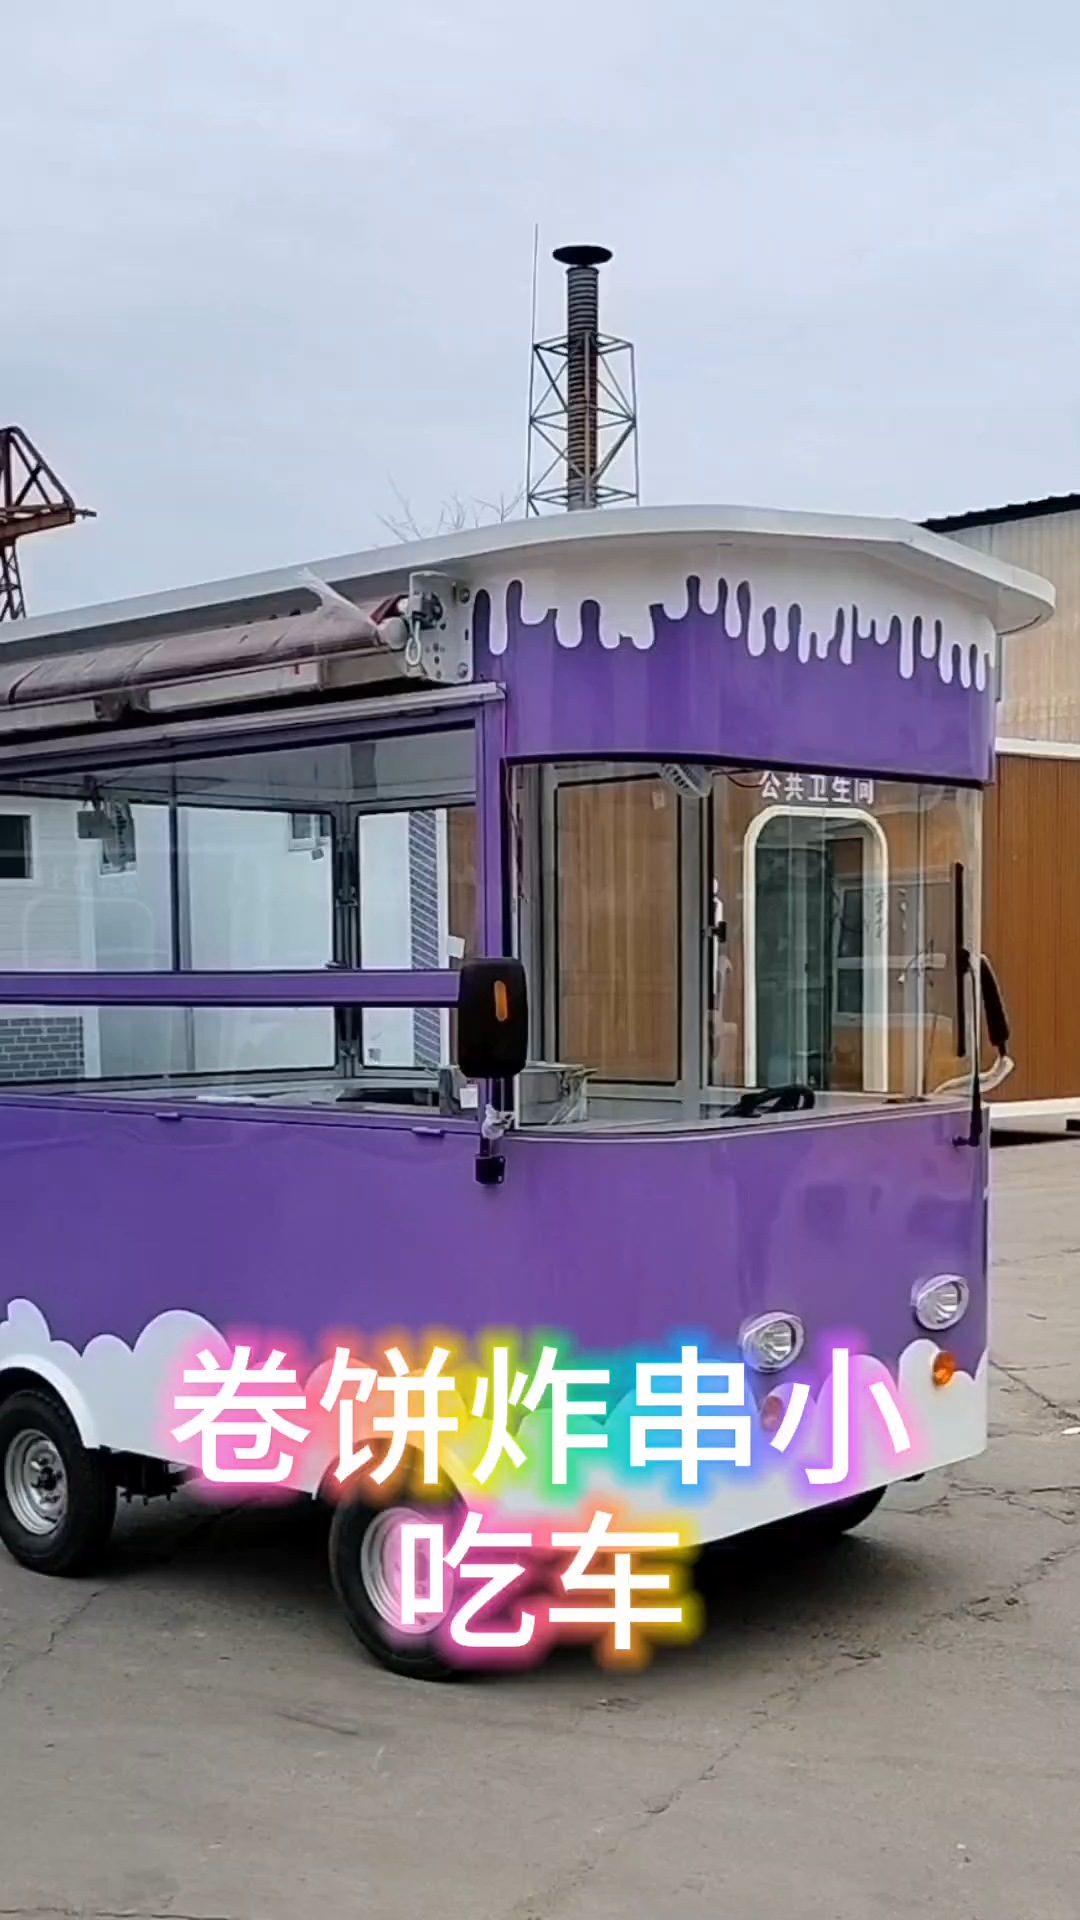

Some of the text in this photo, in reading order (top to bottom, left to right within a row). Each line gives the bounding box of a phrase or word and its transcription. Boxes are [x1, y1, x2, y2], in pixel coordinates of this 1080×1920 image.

[759, 770, 874, 804] 公共卫生间
